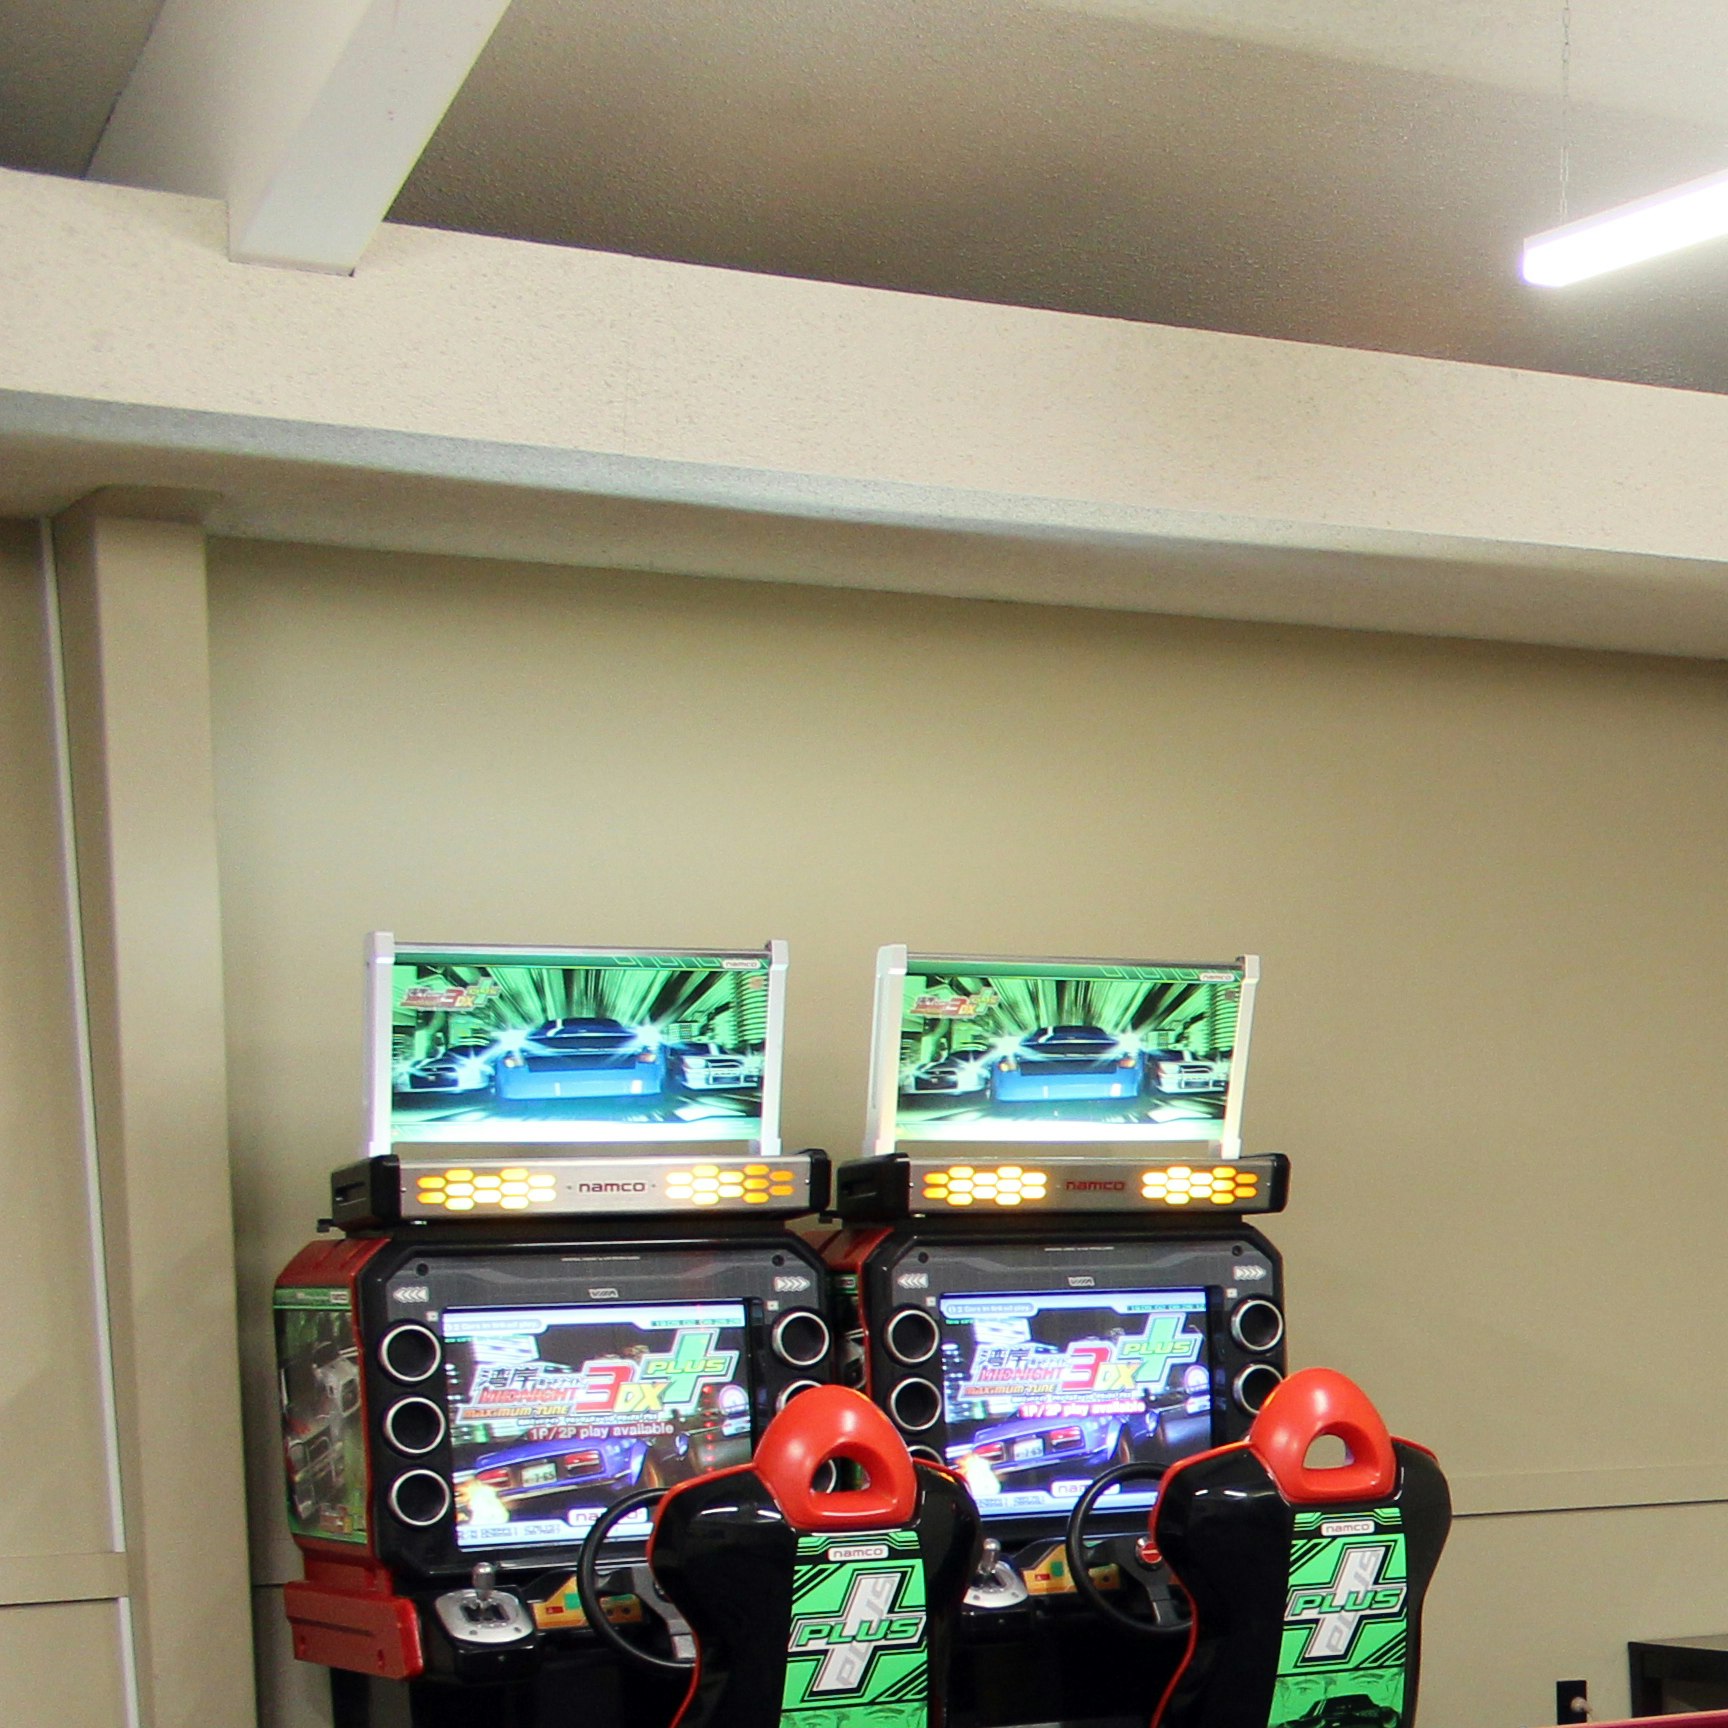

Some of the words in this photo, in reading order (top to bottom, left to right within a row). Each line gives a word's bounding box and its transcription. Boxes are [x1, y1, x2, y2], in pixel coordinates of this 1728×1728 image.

[579, 1180, 646, 1193] namco
[1065, 1179, 1125, 1191] namco
[1123, 1341, 1191, 1355] PLUS
[648, 1359, 726, 1375] PLUS
[1062, 1346, 1110, 1390] 3
[1095, 1362, 1141, 1391] DX
[576, 1365, 634, 1413] 3
[614, 1382, 667, 1412] DX
[1065, 1403, 1090, 1416] play
[1091, 1401, 1145, 1414] available
[531, 1425, 577, 1440] 1P/2P
[580, 1424, 608, 1440] play
[613, 1422, 674, 1437] available
[1326, 1522, 1370, 1533] namco
[832, 1546, 884, 1558] namco
[1291, 1588, 1402, 1617] PLUS
[799, 1617, 921, 1647] PLUS
